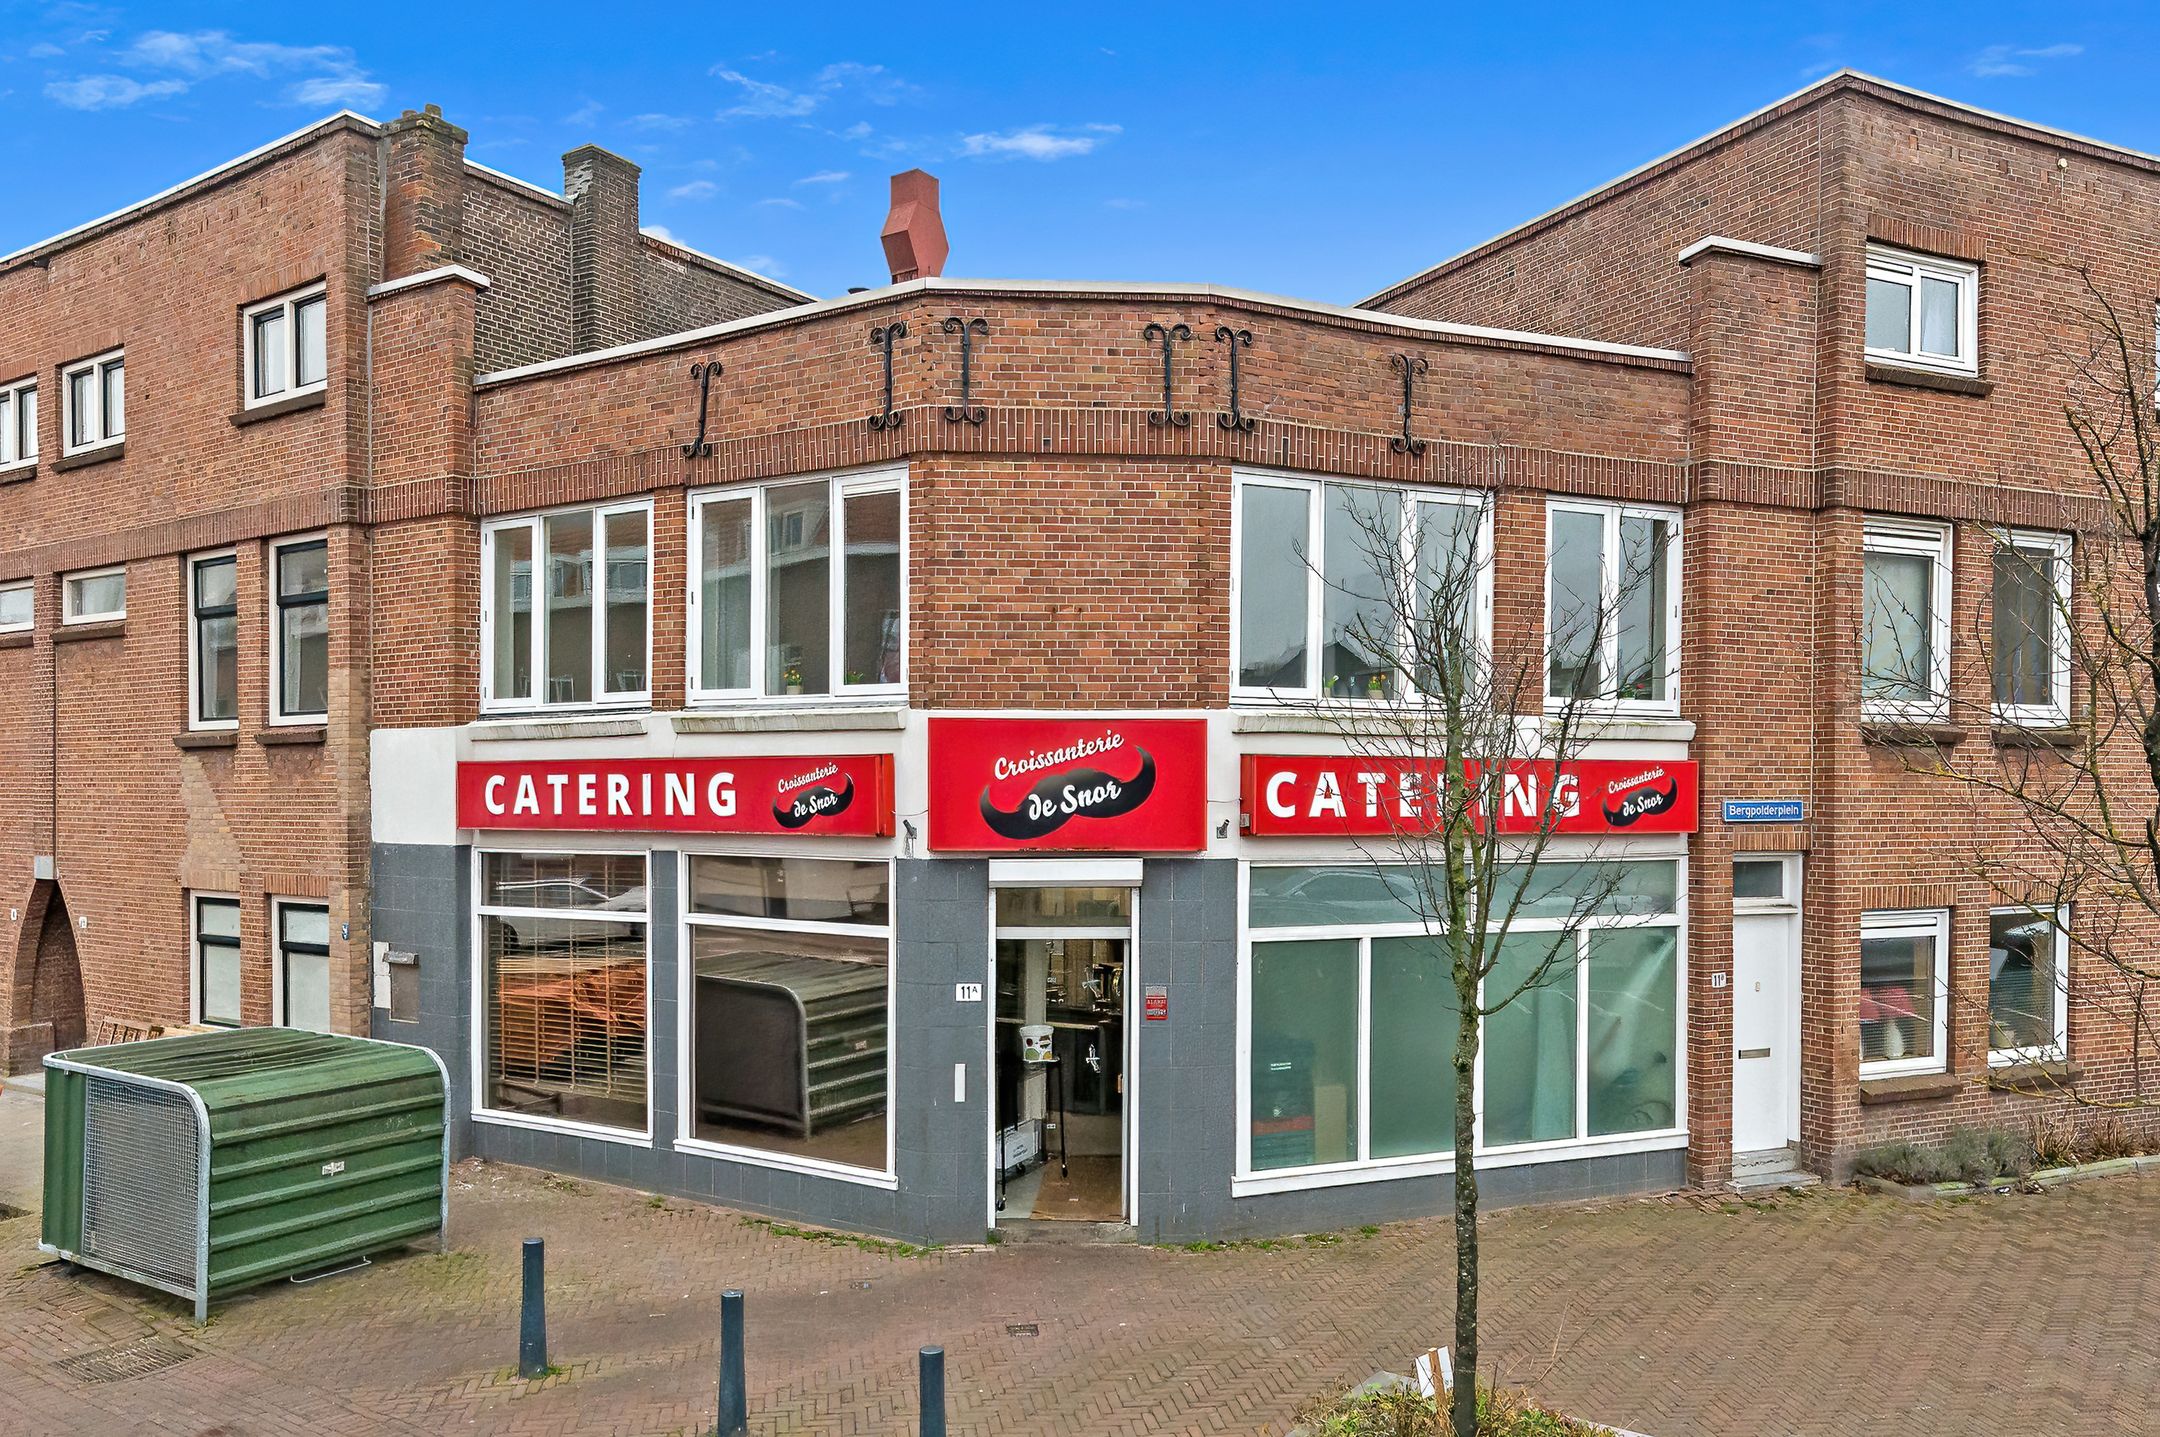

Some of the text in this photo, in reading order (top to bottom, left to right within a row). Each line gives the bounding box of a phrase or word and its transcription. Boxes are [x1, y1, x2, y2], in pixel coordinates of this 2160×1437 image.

[994, 729, 1124, 781] Croissanterie
[777, 762, 838, 793] Croissanterie
[1608, 766, 1665, 794] Croissanterie
[484, 772, 737, 817] CATERING
[793, 793, 838, 817] de Snor
[1028, 781, 1122, 821] de Snor
[1623, 794, 1664, 817] de Snor
[1729, 804, 1799, 819] Bergpolderplein
[960, 985, 978, 1000] 11A
